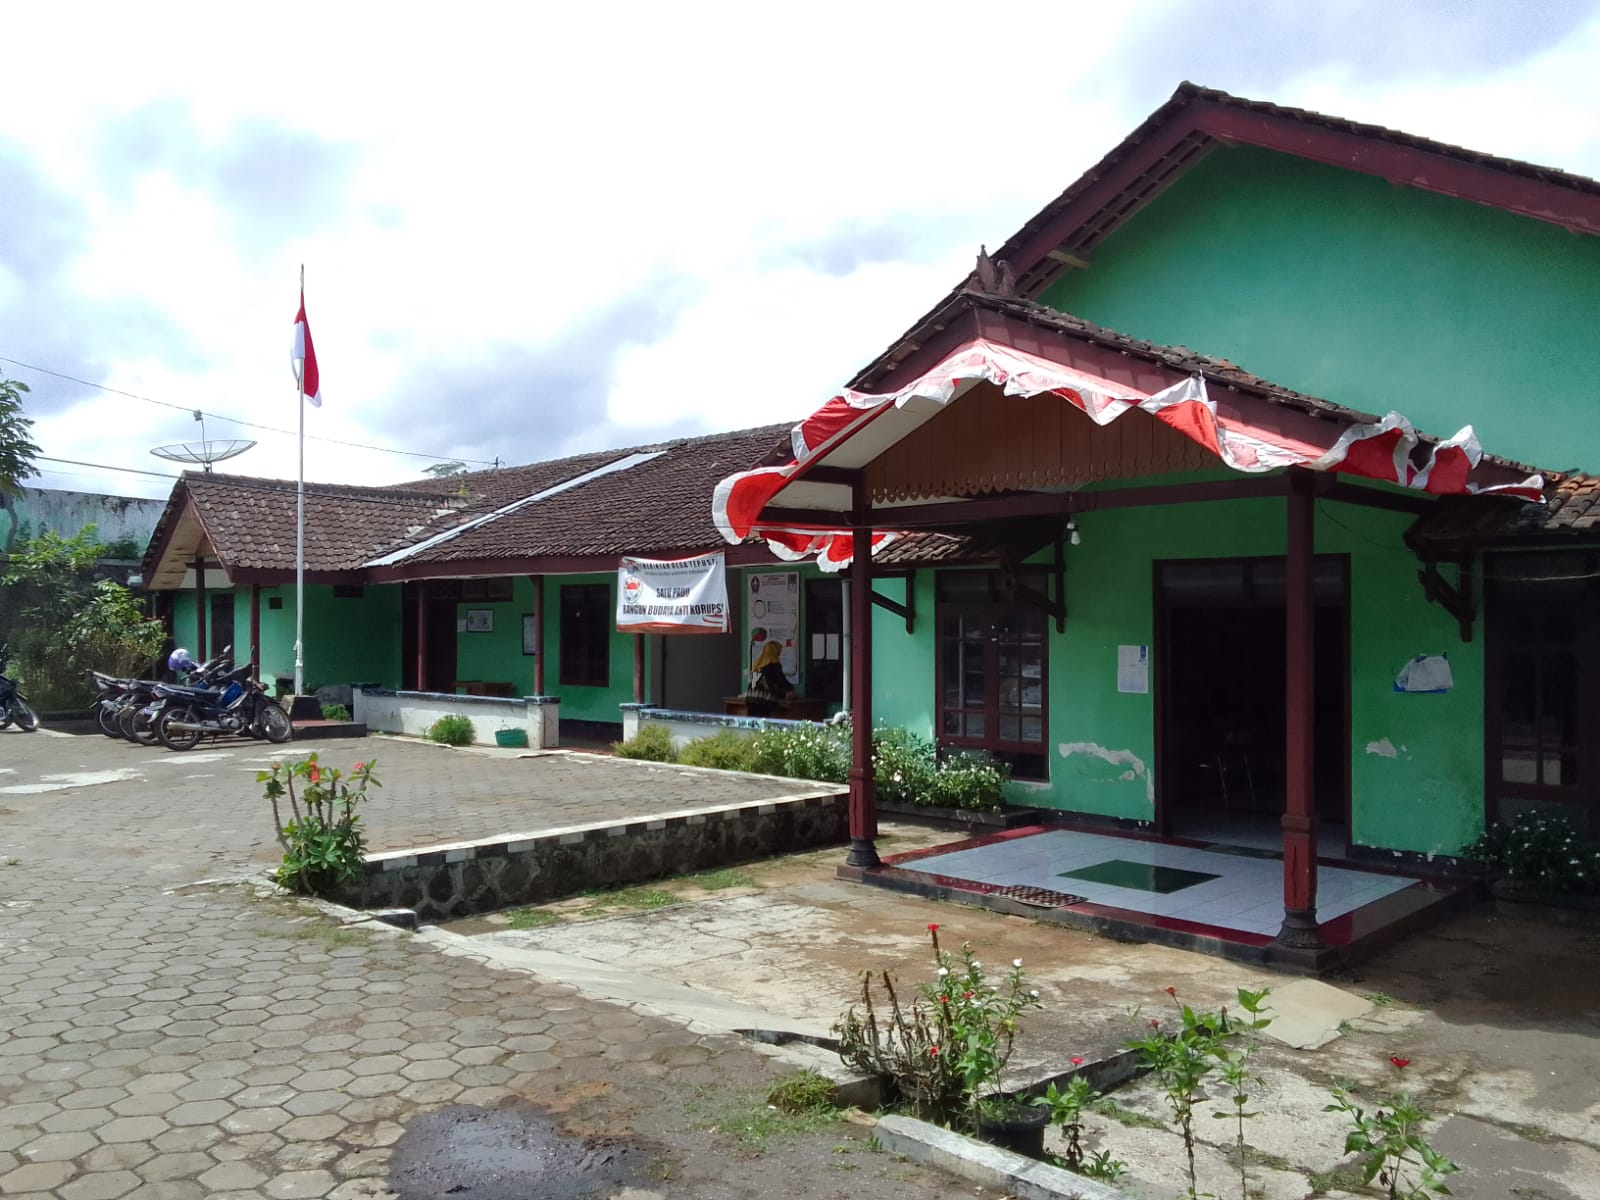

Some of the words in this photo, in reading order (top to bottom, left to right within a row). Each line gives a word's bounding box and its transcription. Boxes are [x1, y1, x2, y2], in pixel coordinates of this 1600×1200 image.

[657, 587, 671, 598] SATU
[672, 587, 690, 598] PADU
[623, 605, 647, 614] BANGUN
[648, 605, 673, 616] BUDAYA
[674, 605, 689, 615] ANTI
